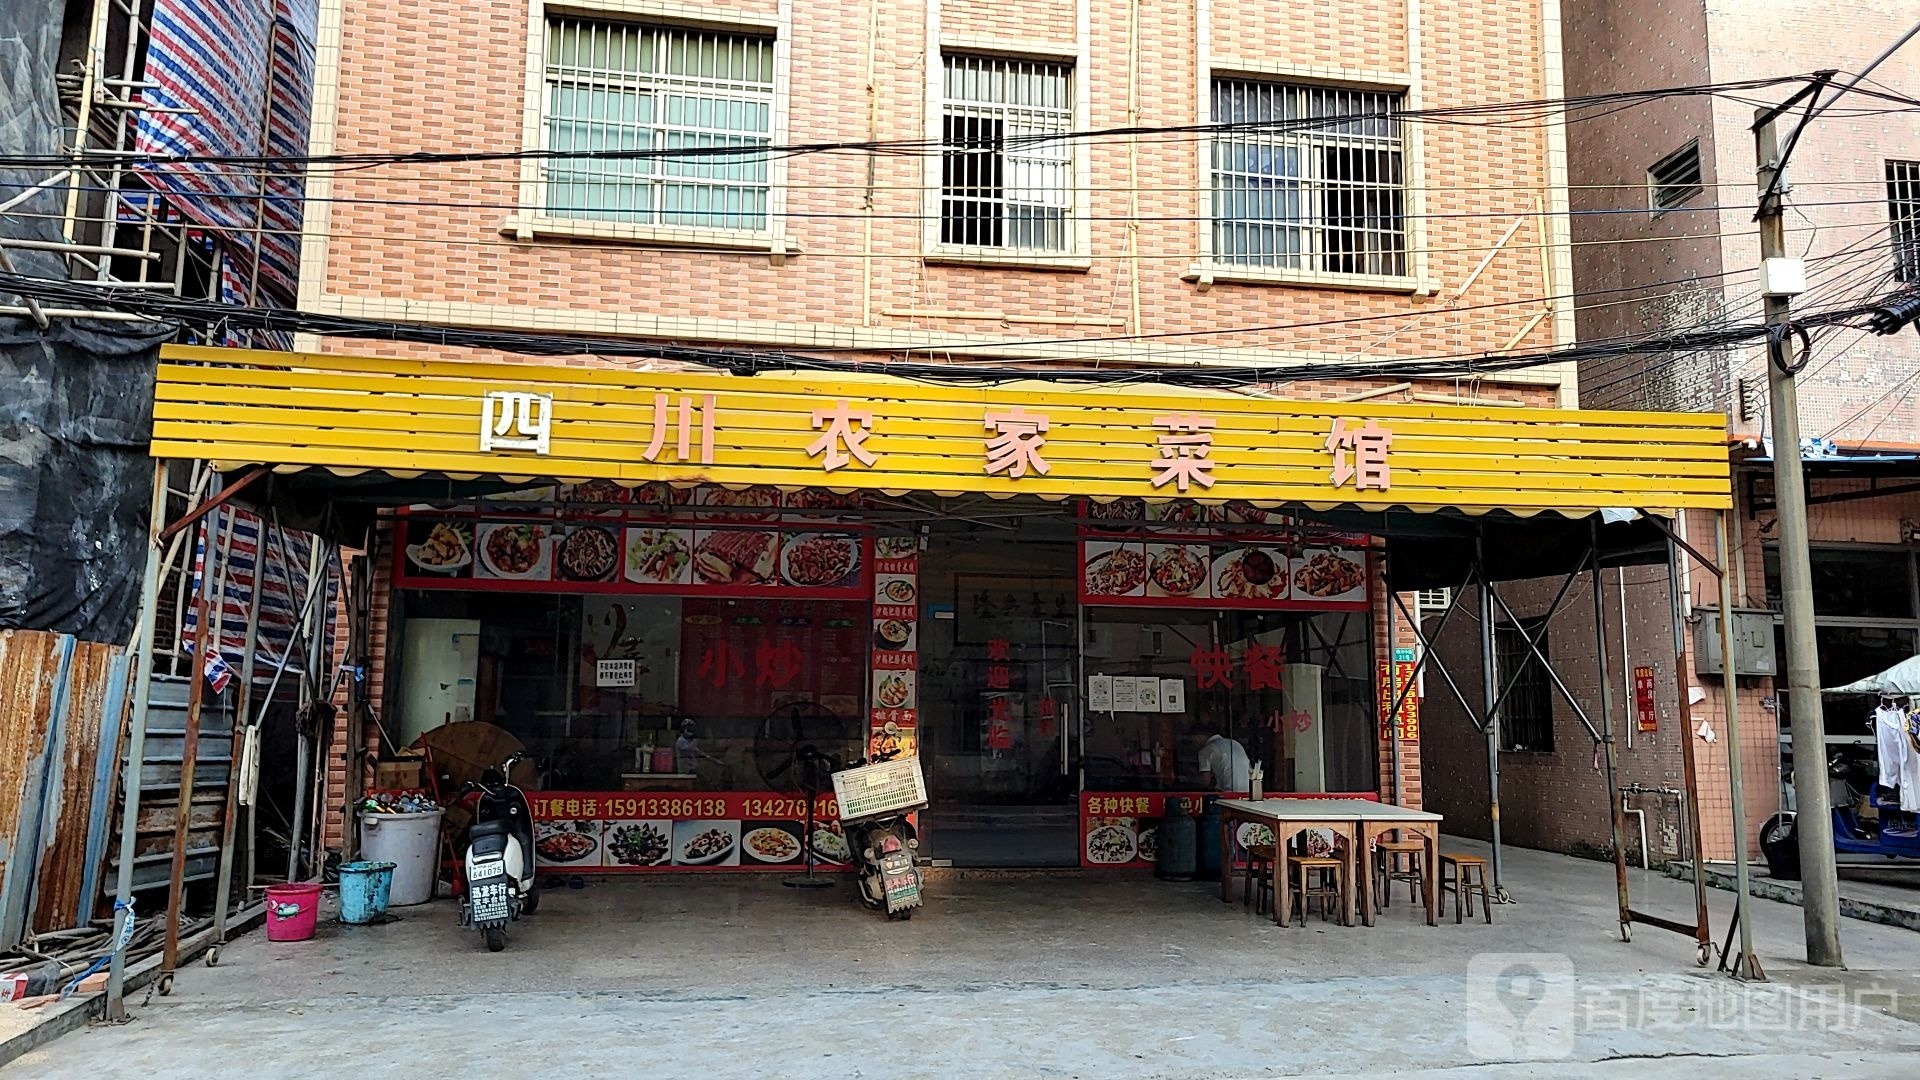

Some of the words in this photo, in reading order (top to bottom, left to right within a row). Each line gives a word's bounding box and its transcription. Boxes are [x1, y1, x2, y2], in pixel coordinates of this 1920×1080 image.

[480, 390, 1393, 492] 四川农家菜馆
[698, 639, 802, 687] 小炒
[1190, 641, 1284, 691] 快餐
[1087, 797, 1151, 814] 各种快餐
[473, 866, 502, 879] 641075
